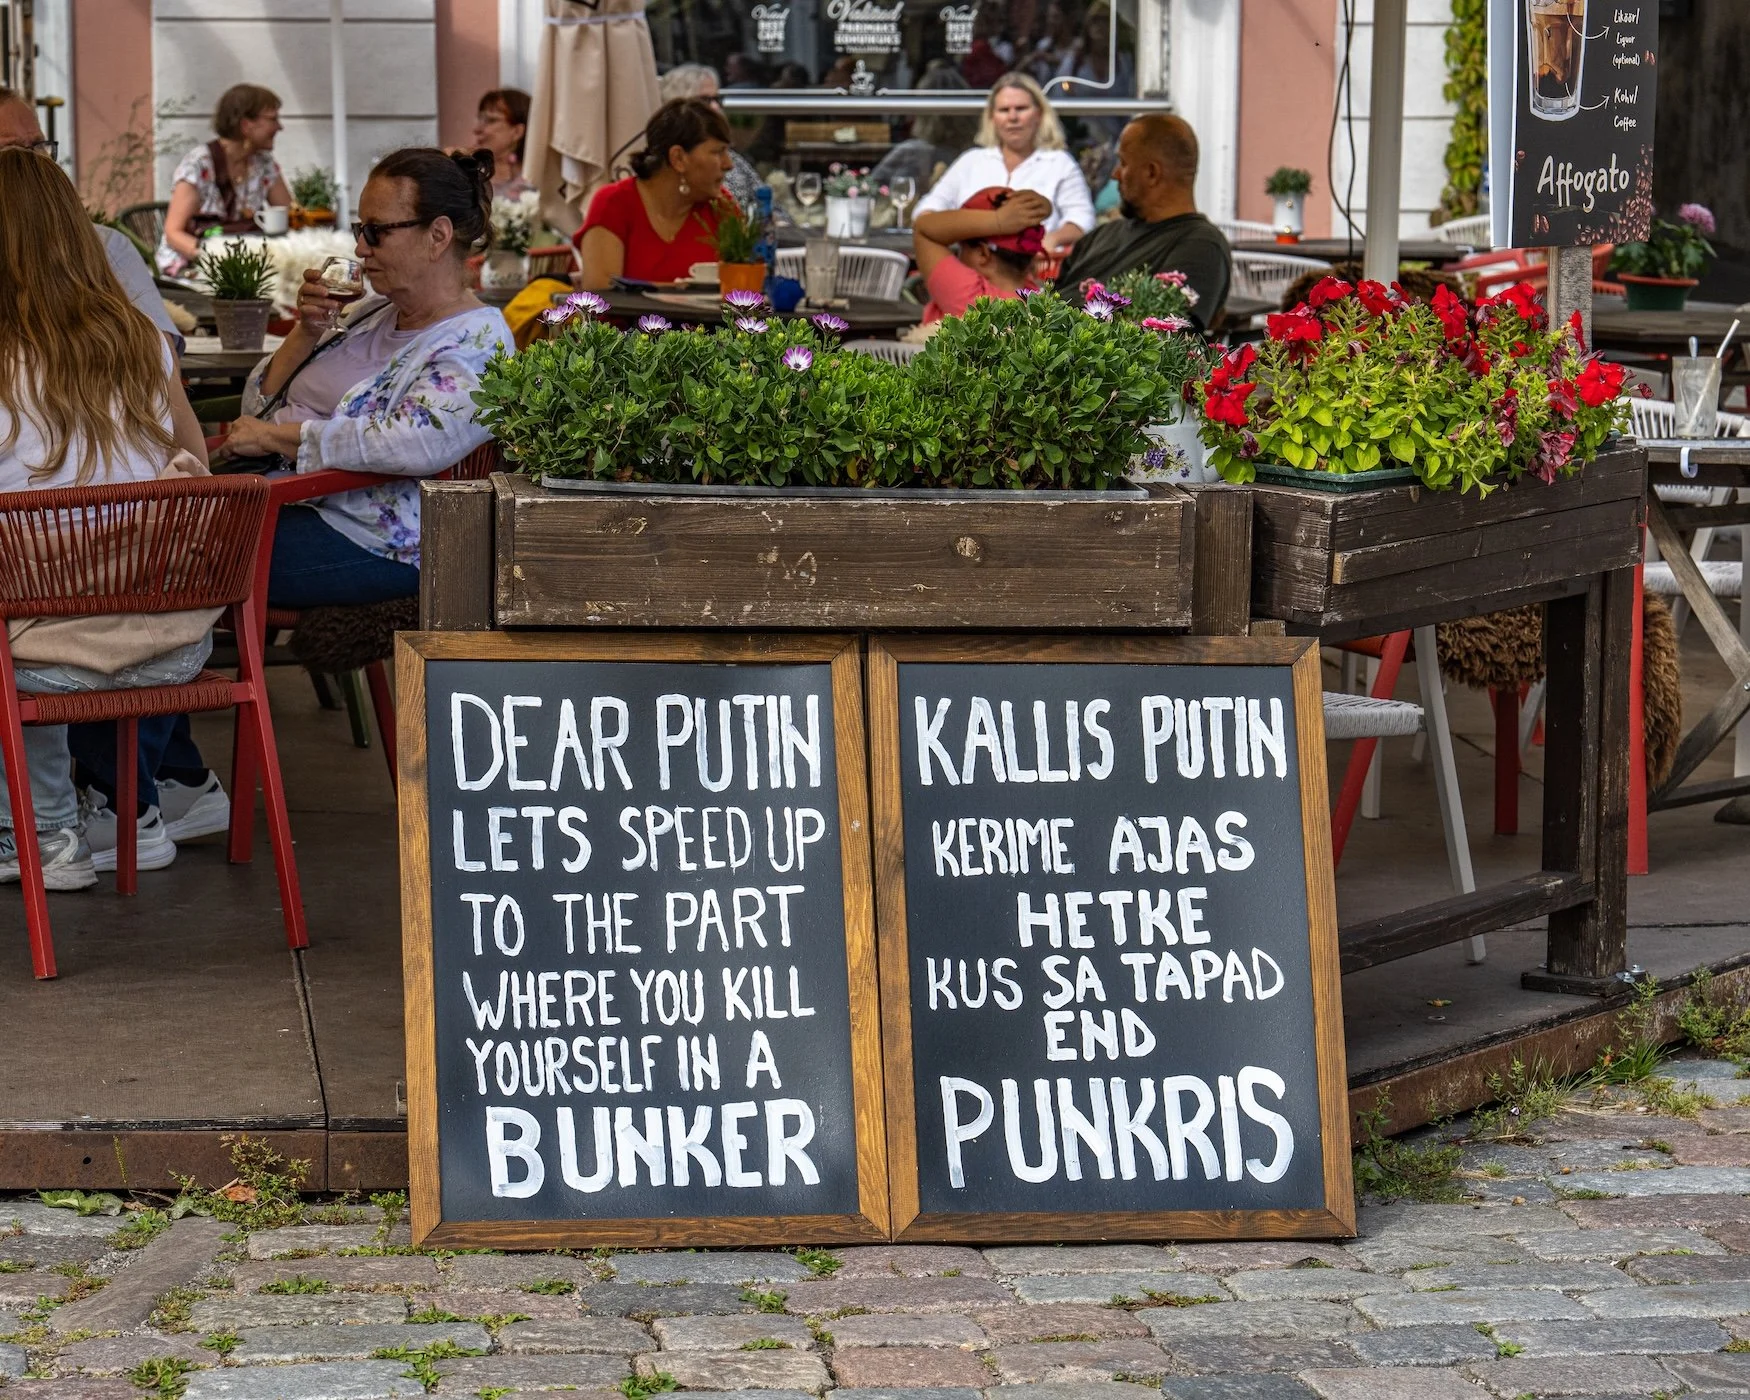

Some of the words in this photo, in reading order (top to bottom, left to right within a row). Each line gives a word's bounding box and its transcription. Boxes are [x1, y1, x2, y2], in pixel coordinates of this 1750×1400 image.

[1612, 53, 1640, 70] (optional)
[1616, 32, 1636, 48] Liquor
[1613, 115, 1637, 131] Coffee
[1614, 85, 1639, 104] Kohv/
[1537, 153, 1630, 213] Affogato
[451, 692, 633, 791] DEAR
[656, 694, 821, 792] PUTIN
[915, 696, 1114, 786] KALLIS
[1141, 695, 1287, 783] PUTIN
[453, 806, 591, 873] LETS
[620, 805, 752, 872] SPEED
[766, 806, 825, 872] UP
[932, 818, 1075, 876] KERIME
[1109, 811, 1255, 874] AJAS
[460, 893, 524, 956] TO
[552, 892, 641, 954] THE
[666, 885, 805, 953] PART
[1017, 887, 1211, 948] HETKE
[463, 970, 621, 1030] WHERE
[630, 968, 704, 1027] YOU
[722, 965, 816, 1021] KILL
[926, 957, 1023, 1010] KUS
[1041, 955, 1106, 1009] SA
[1120, 947, 1284, 1003] TAPAD
[466, 1035, 662, 1096] YOURSELF
[677, 1033, 720, 1091] IN
[745, 1029, 782, 1089] A
[1045, 1010, 1156, 1061] END
[486, 1098, 820, 1198] BUNKER
[940, 1066, 1294, 1188] PUNKRIS
